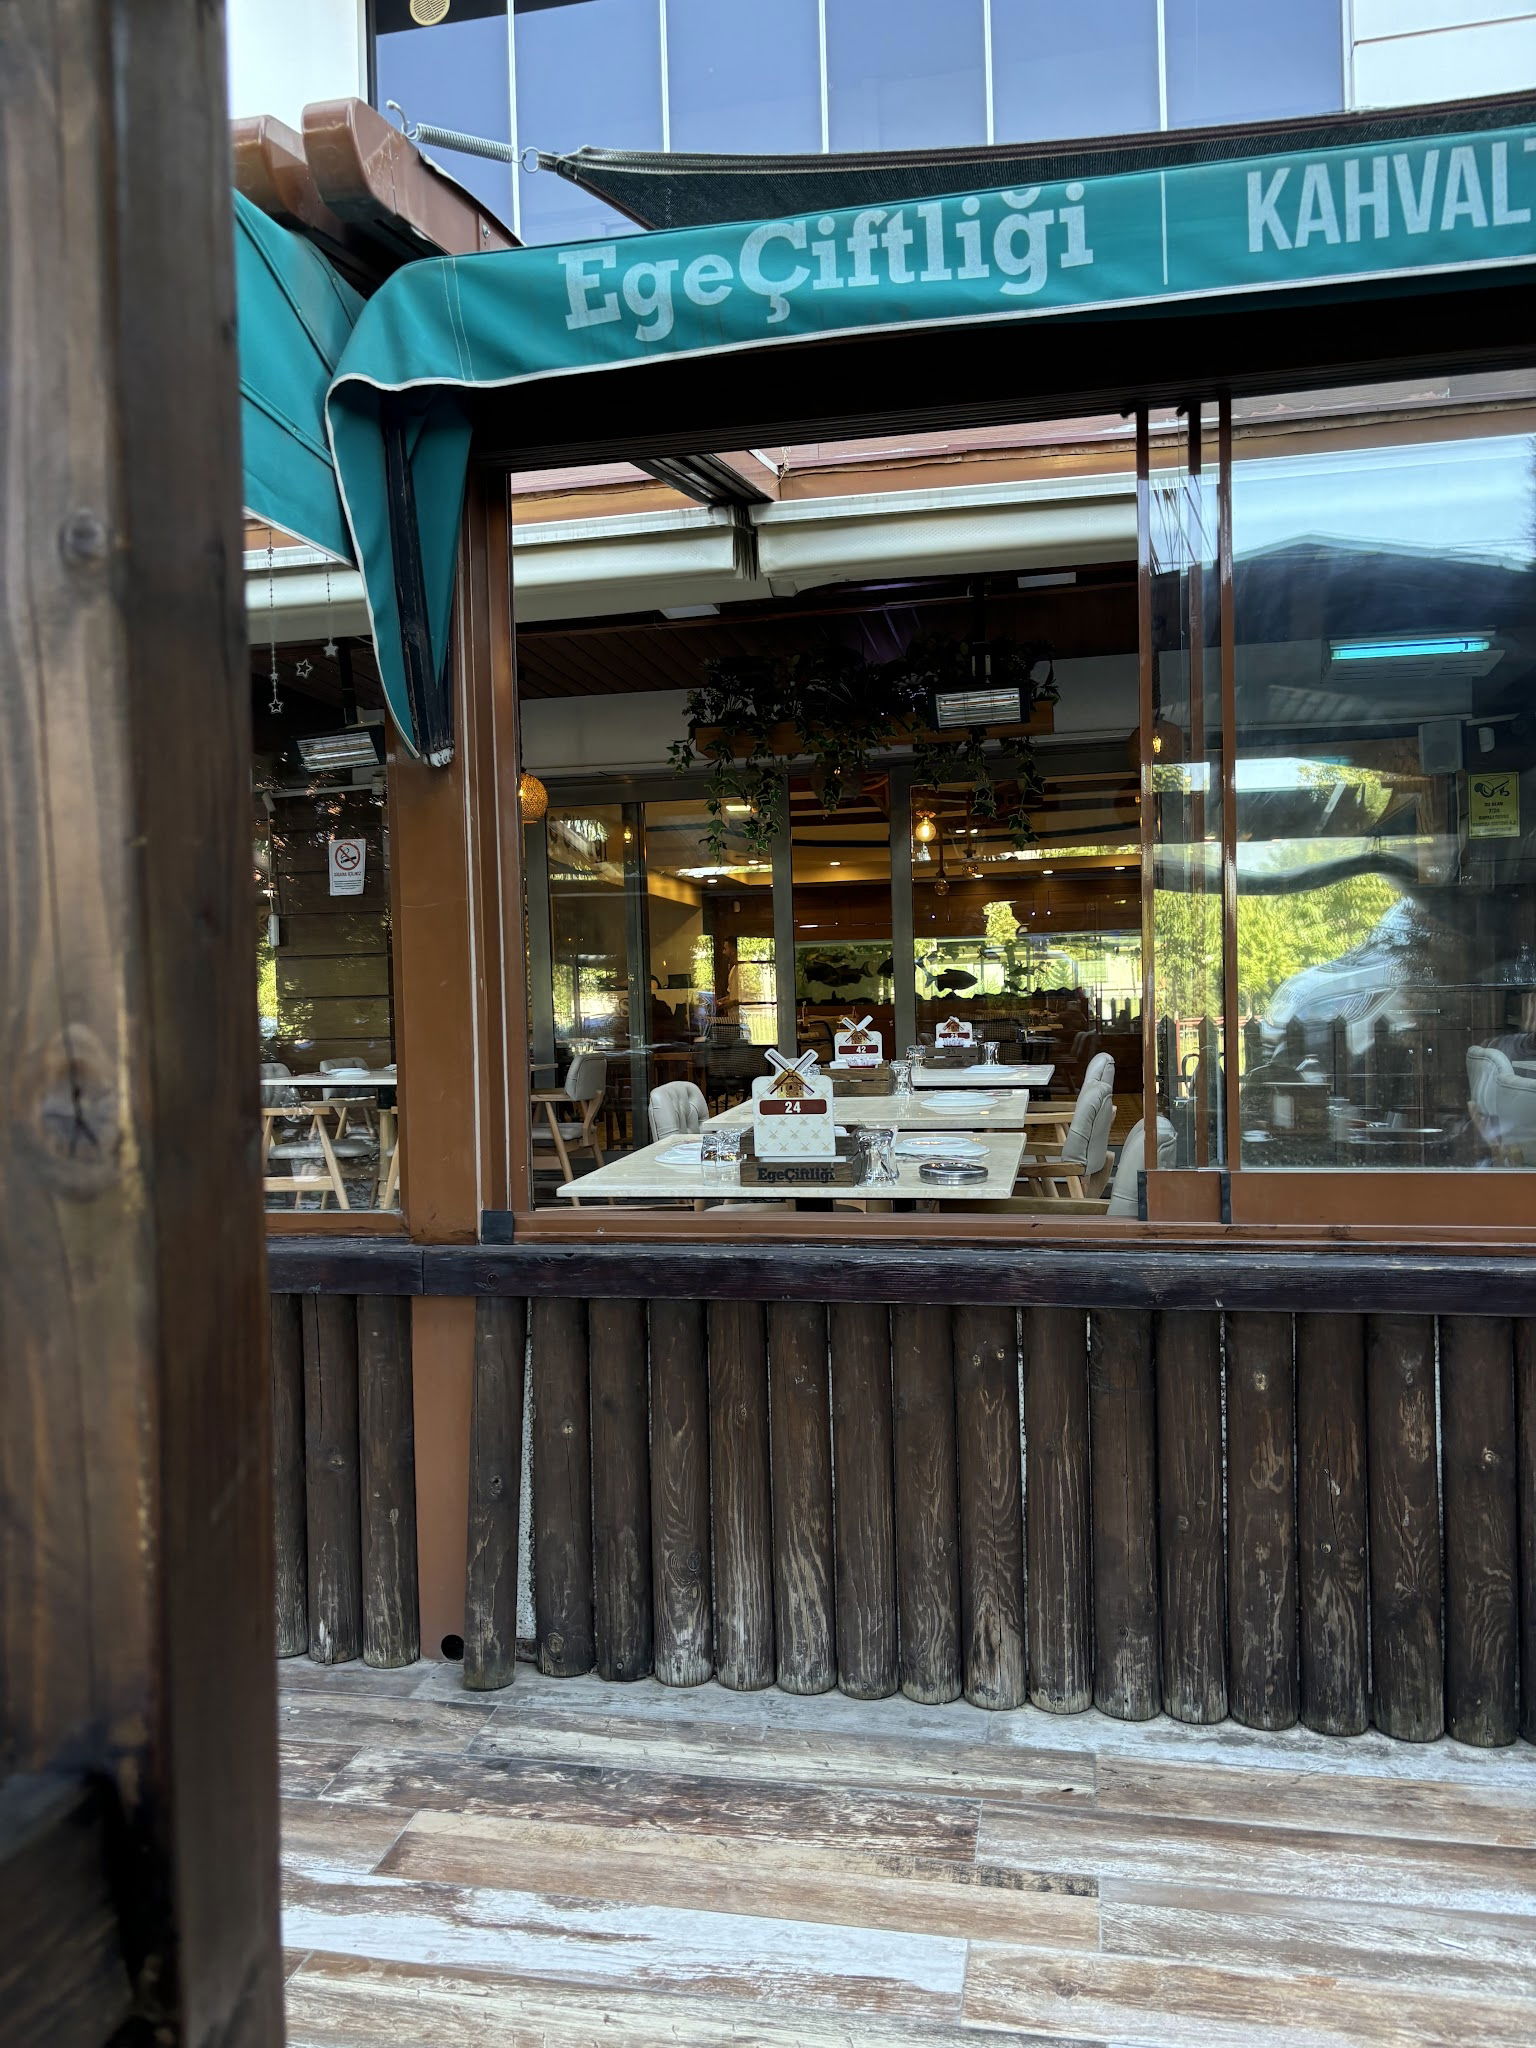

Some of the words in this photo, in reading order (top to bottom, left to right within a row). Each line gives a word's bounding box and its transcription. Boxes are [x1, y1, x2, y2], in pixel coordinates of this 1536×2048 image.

[558, 182, 1094, 341] EgeÇiftliği
[856, 1046, 867, 1054] 42
[784, 1101, 802, 1114] 24
[757, 1167, 835, 1184] EgeÇiftliği
